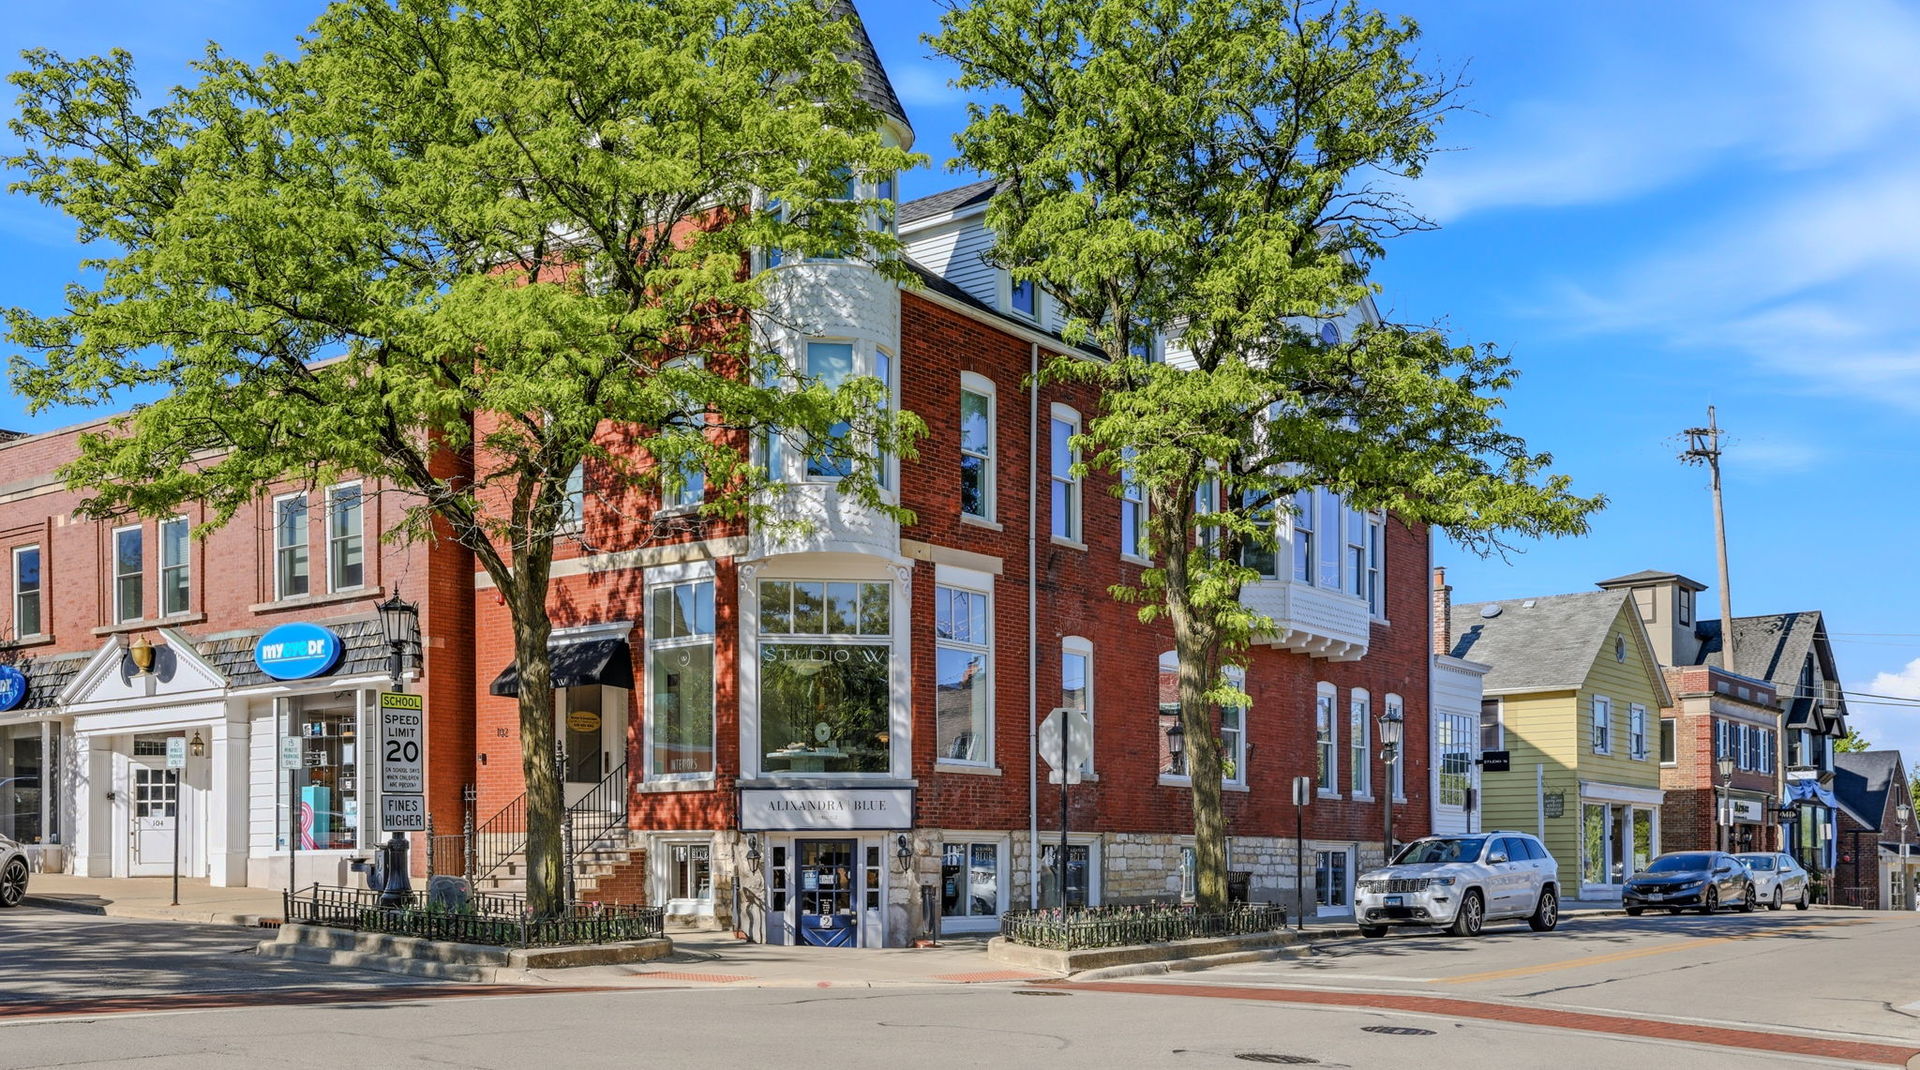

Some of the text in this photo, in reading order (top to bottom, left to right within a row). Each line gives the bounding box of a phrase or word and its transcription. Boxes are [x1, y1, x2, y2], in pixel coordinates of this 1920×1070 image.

[764, 648, 885, 663] STUDIO W
[557, 678, 567, 686] W
[383, 696, 420, 708] SCHOOL
[385, 714, 419, 726] SPEED
[388, 727, 416, 738] LIMIT
[386, 740, 419, 763] 20
[388, 800, 418, 812] FINES
[768, 800, 887, 811] ALIXANDRA BLUE
[385, 813, 422, 827] HIGHER
[822, 917, 830, 927] 2
